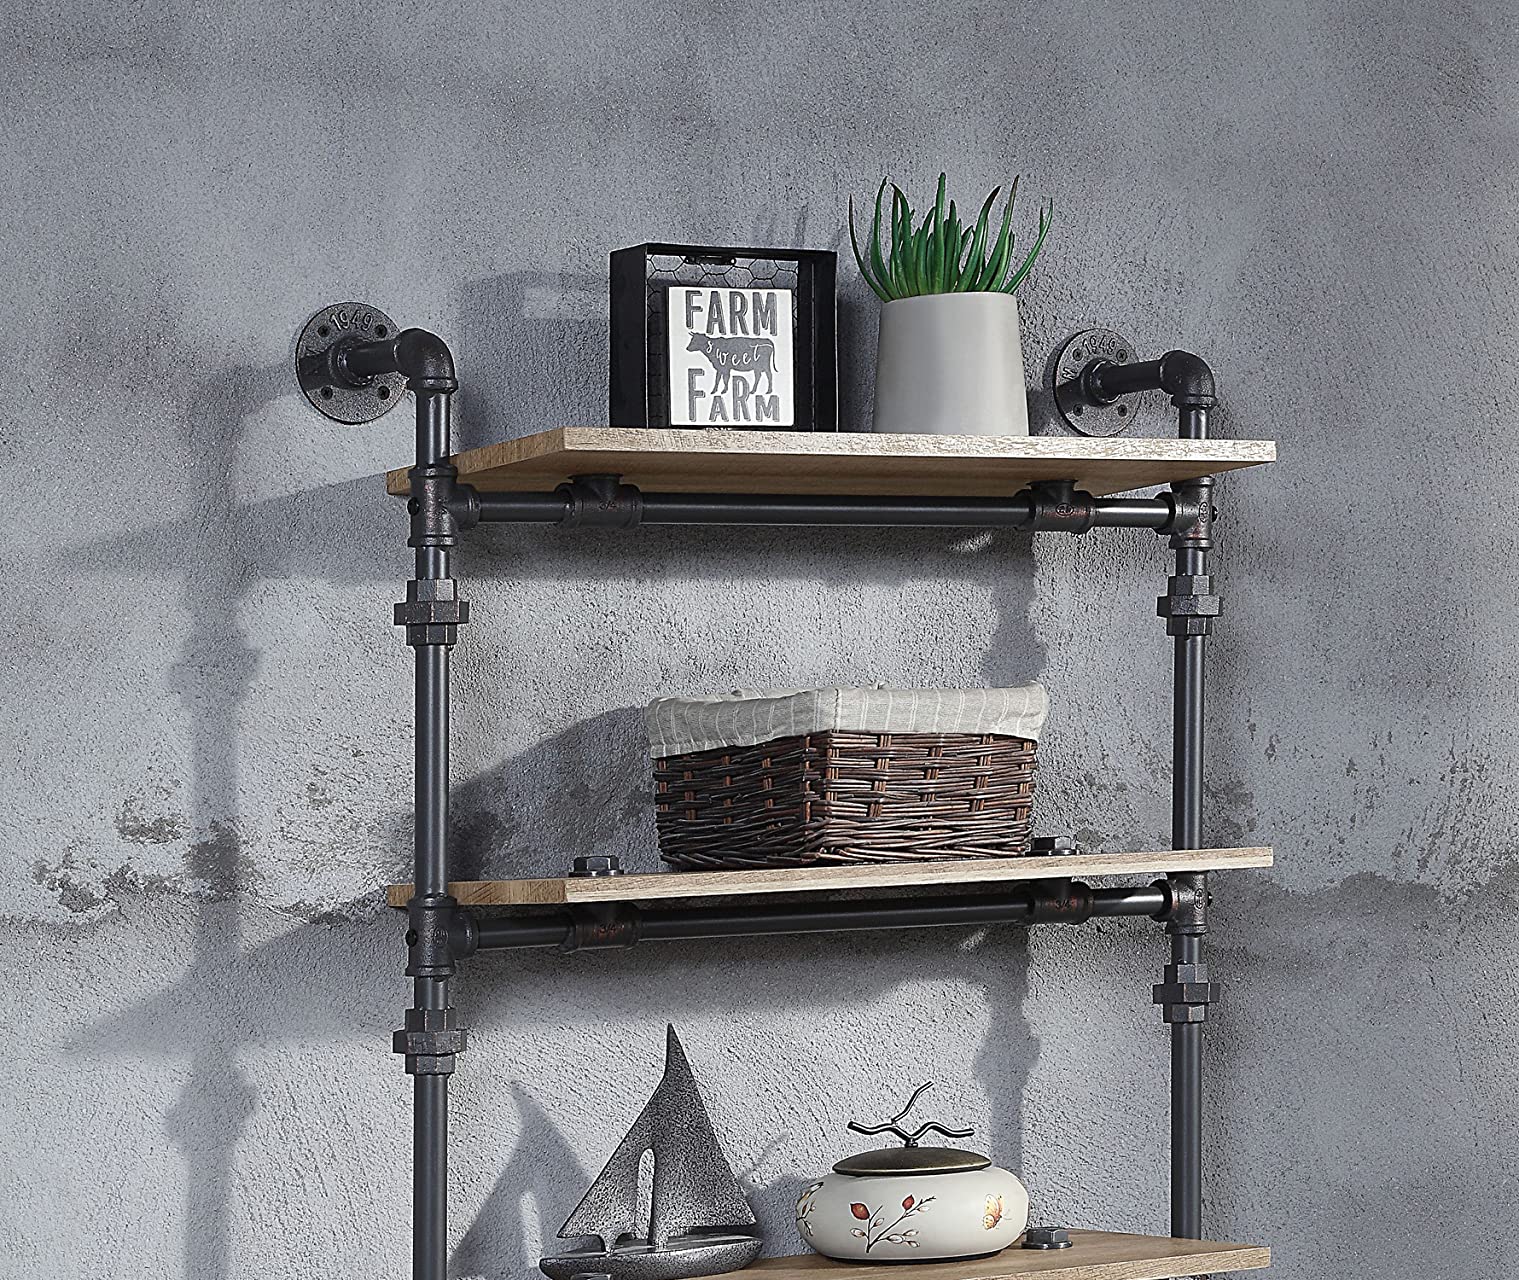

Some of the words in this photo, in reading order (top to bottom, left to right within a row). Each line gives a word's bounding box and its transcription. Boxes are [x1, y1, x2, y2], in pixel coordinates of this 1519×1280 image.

[329, 309, 374, 332] 1949
[685, 290, 778, 337] FARM
[687, 368, 780, 423] FARM
